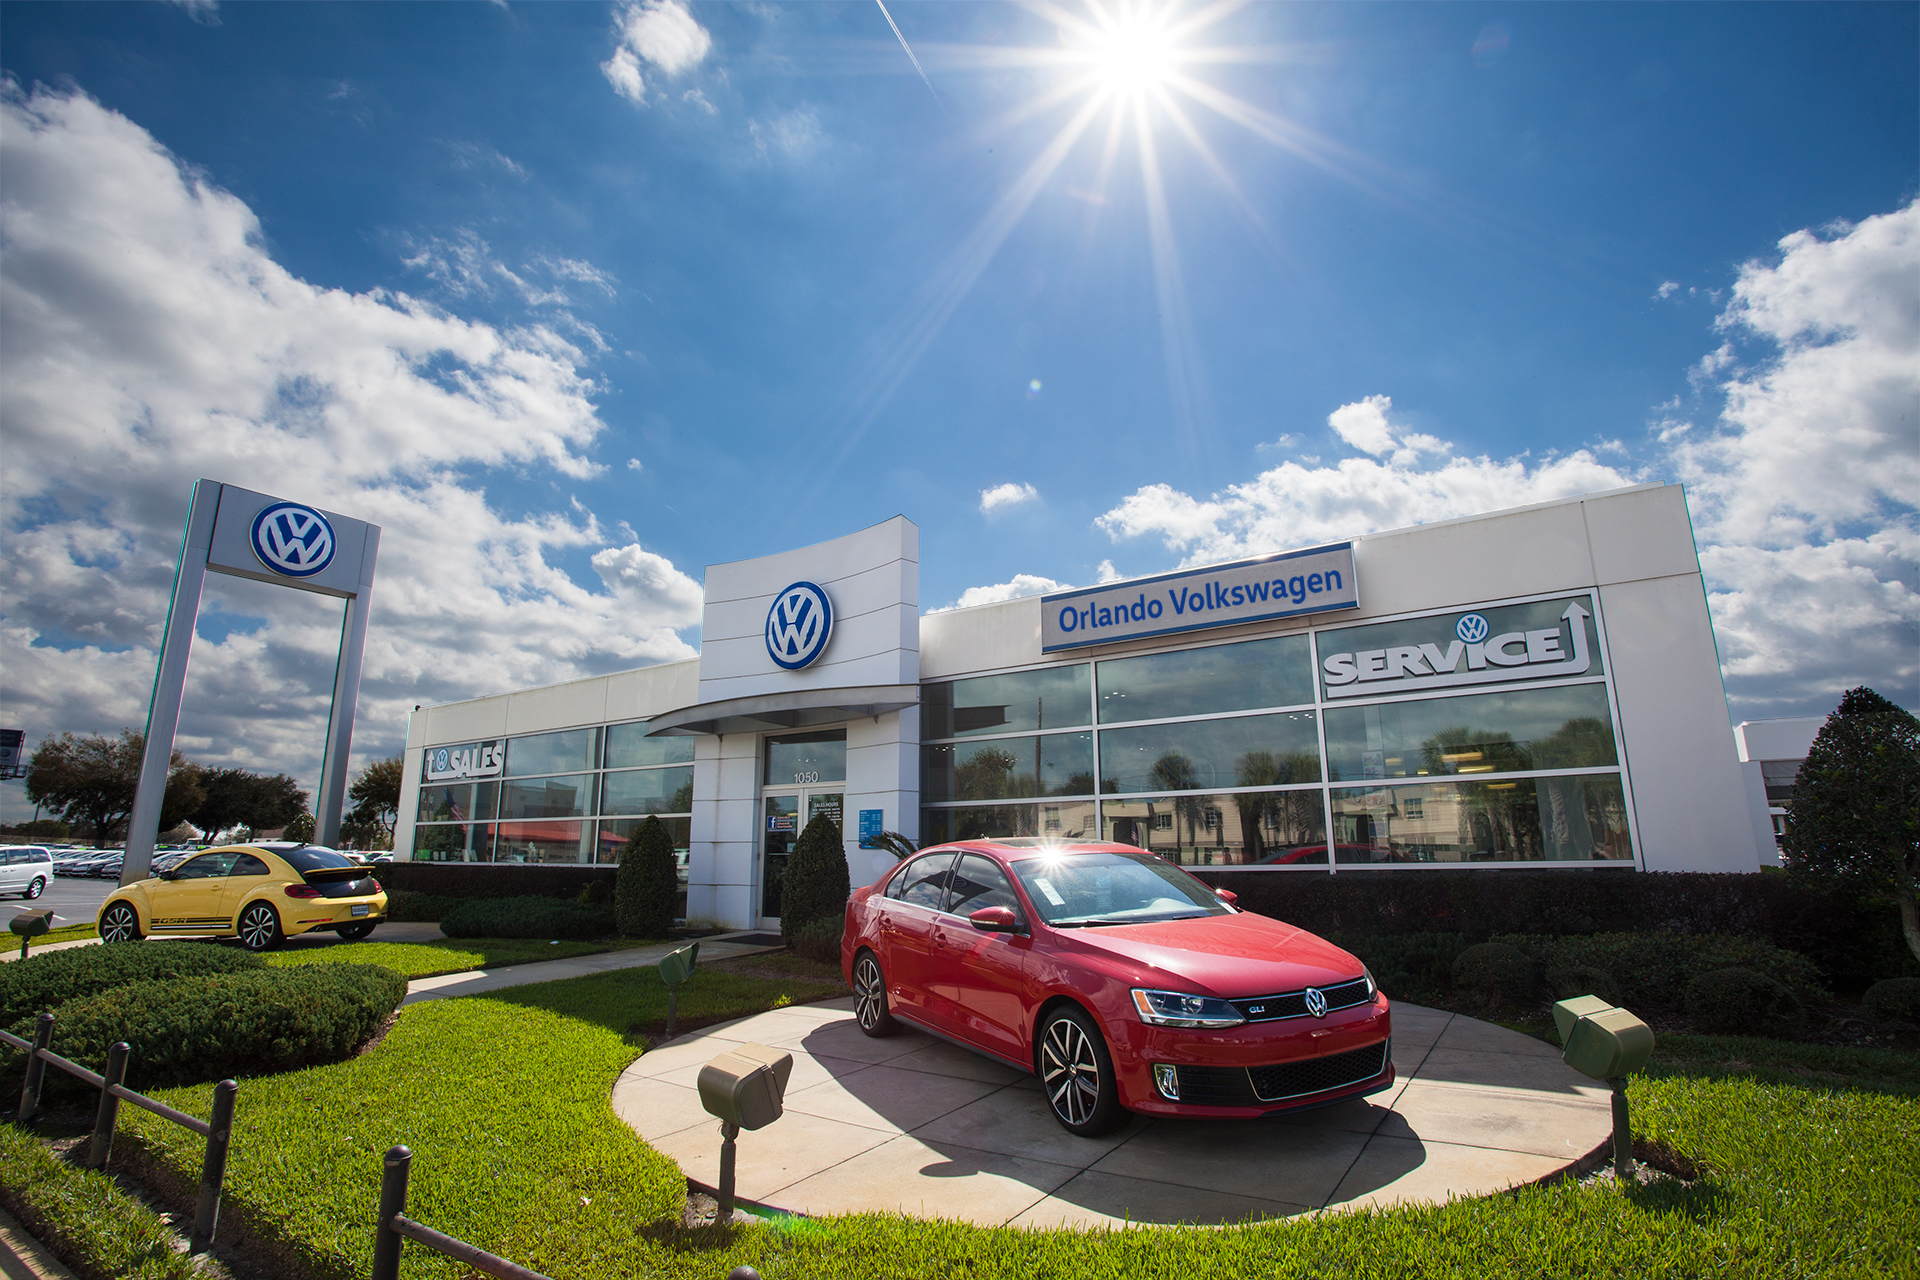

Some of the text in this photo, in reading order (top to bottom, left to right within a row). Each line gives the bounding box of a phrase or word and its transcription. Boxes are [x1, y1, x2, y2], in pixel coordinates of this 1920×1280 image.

[257, 506, 332, 572] VW
[768, 587, 825, 664] VW
[1059, 570, 1343, 633] Orlando Volkswagen
[1323, 627, 1566, 686] SERVICE
[450, 745, 503, 778] SALES
[794, 771, 819, 784] 1050
[1249, 1006, 1265, 1014] GLI
